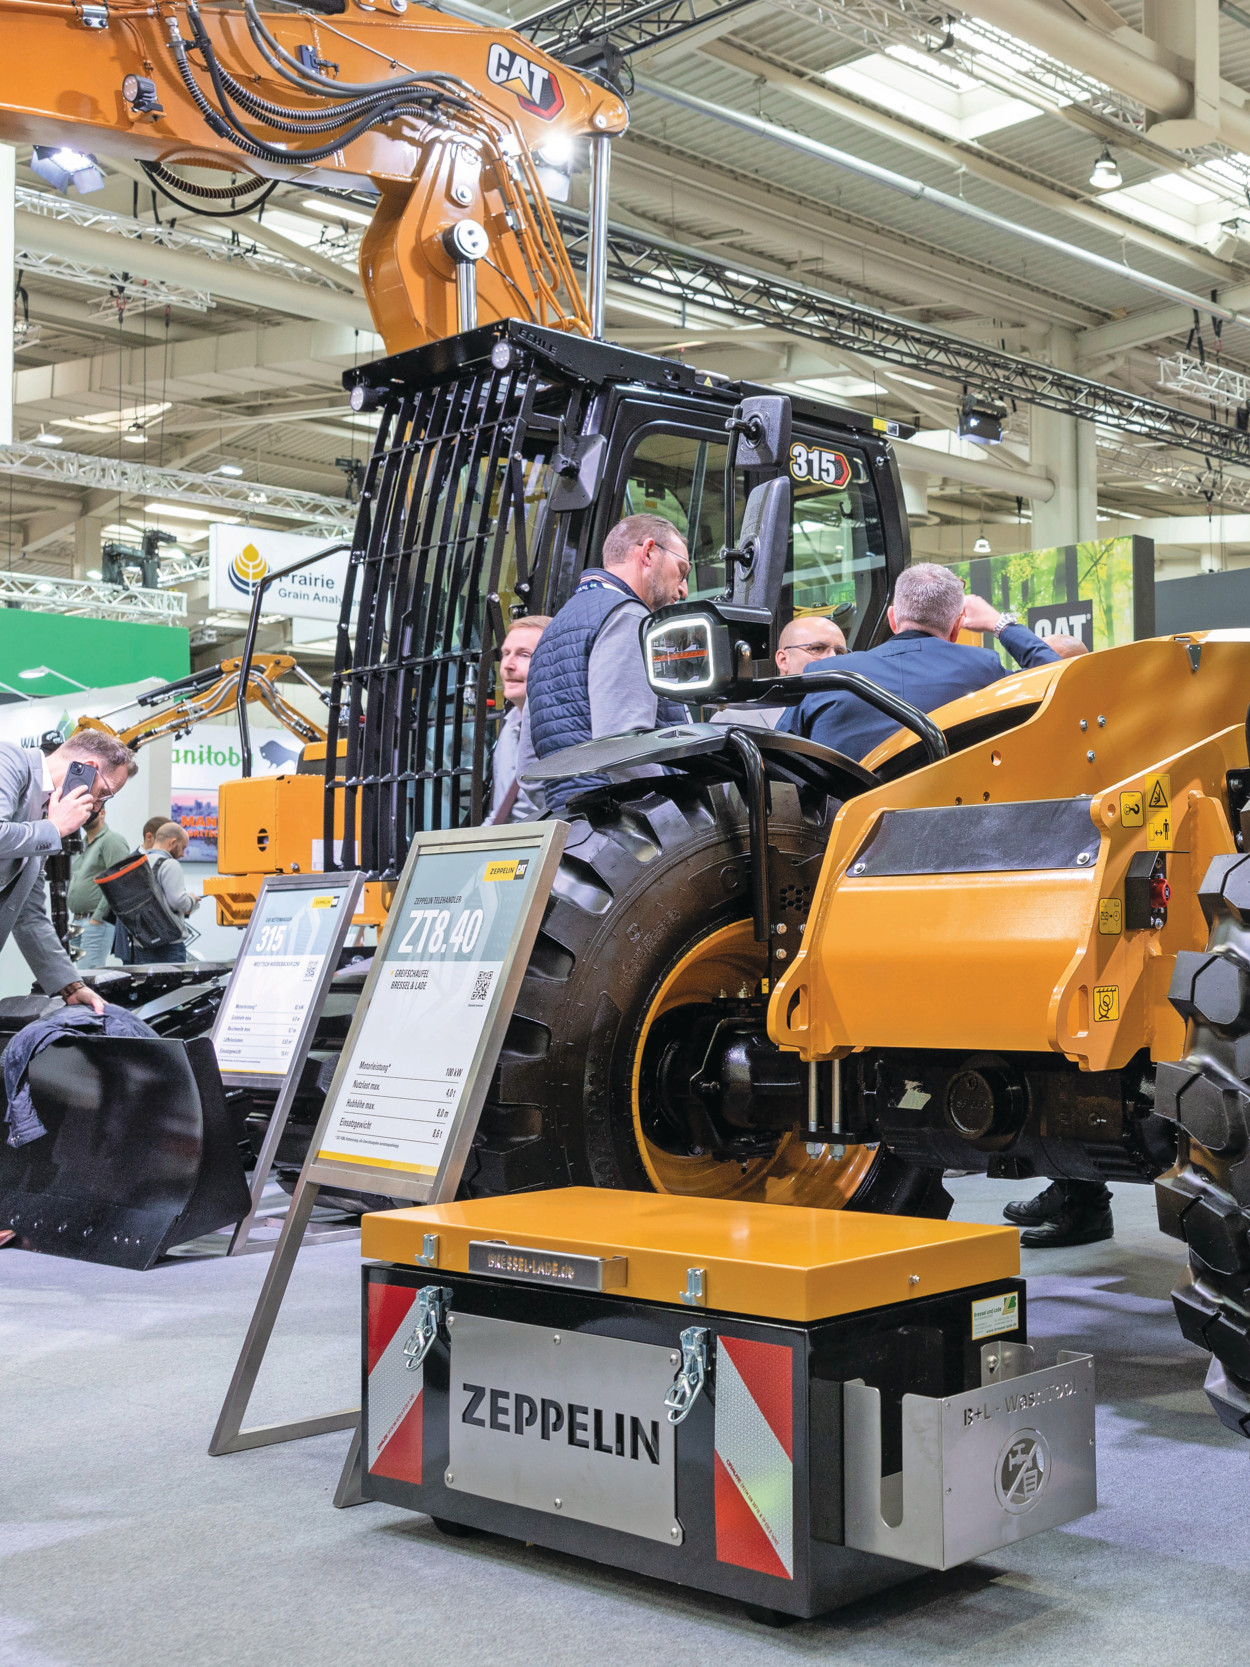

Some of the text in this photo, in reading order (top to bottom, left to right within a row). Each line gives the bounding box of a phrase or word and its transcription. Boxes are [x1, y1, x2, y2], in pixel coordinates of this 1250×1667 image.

[487, 43, 549, 104] CAT
[792, 445, 836, 483] 315
[278, 588, 310, 601] Grain
[489, 864, 527, 876] ZEPPELIN CAT
[256, 925, 286, 952] 315
[398, 909, 484, 953] ZT8.40
[462, 1382, 661, 1465] ZEPPELIN
[963, 1403, 991, 1426] B+L
